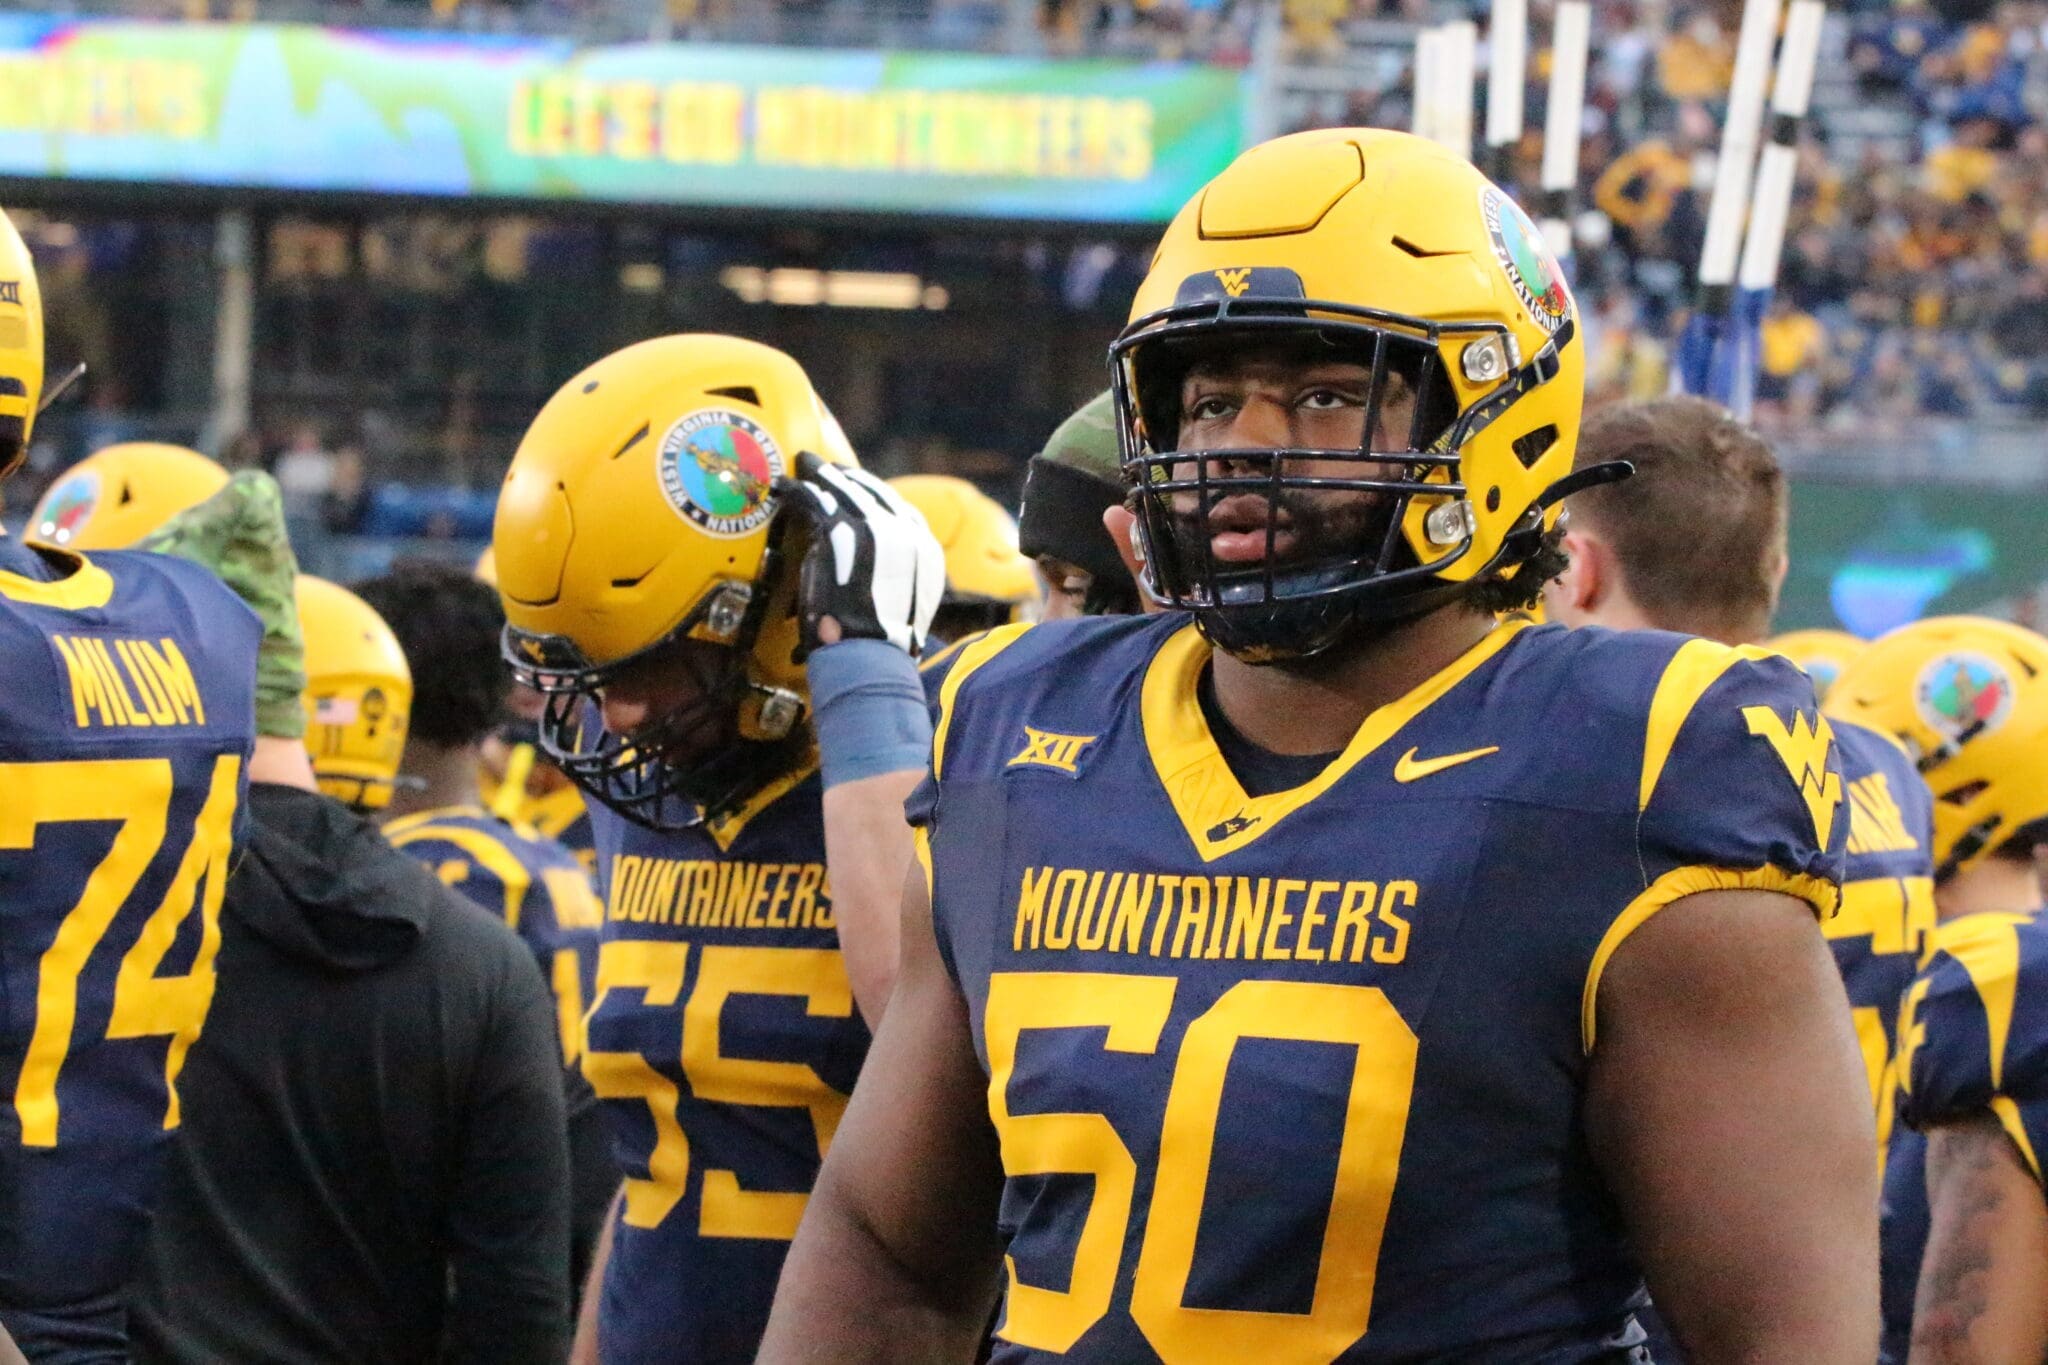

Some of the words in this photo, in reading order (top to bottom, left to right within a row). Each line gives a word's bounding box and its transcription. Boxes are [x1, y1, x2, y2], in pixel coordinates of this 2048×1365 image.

[1508, 263, 1561, 331] NATIONAL
[664, 411, 732, 451] VIRGINIA
[662, 459, 690, 508] WEST
[53, 634, 206, 728] MILUM
[1006, 725, 1098, 773] XII
[607, 853, 837, 929] OUNTAINEERS
[1013, 866, 1418, 965] MOUNTAINEERS
[0, 754, 241, 1147] 74
[580, 939, 854, 1240] 55
[984, 971, 1420, 1365] 50
